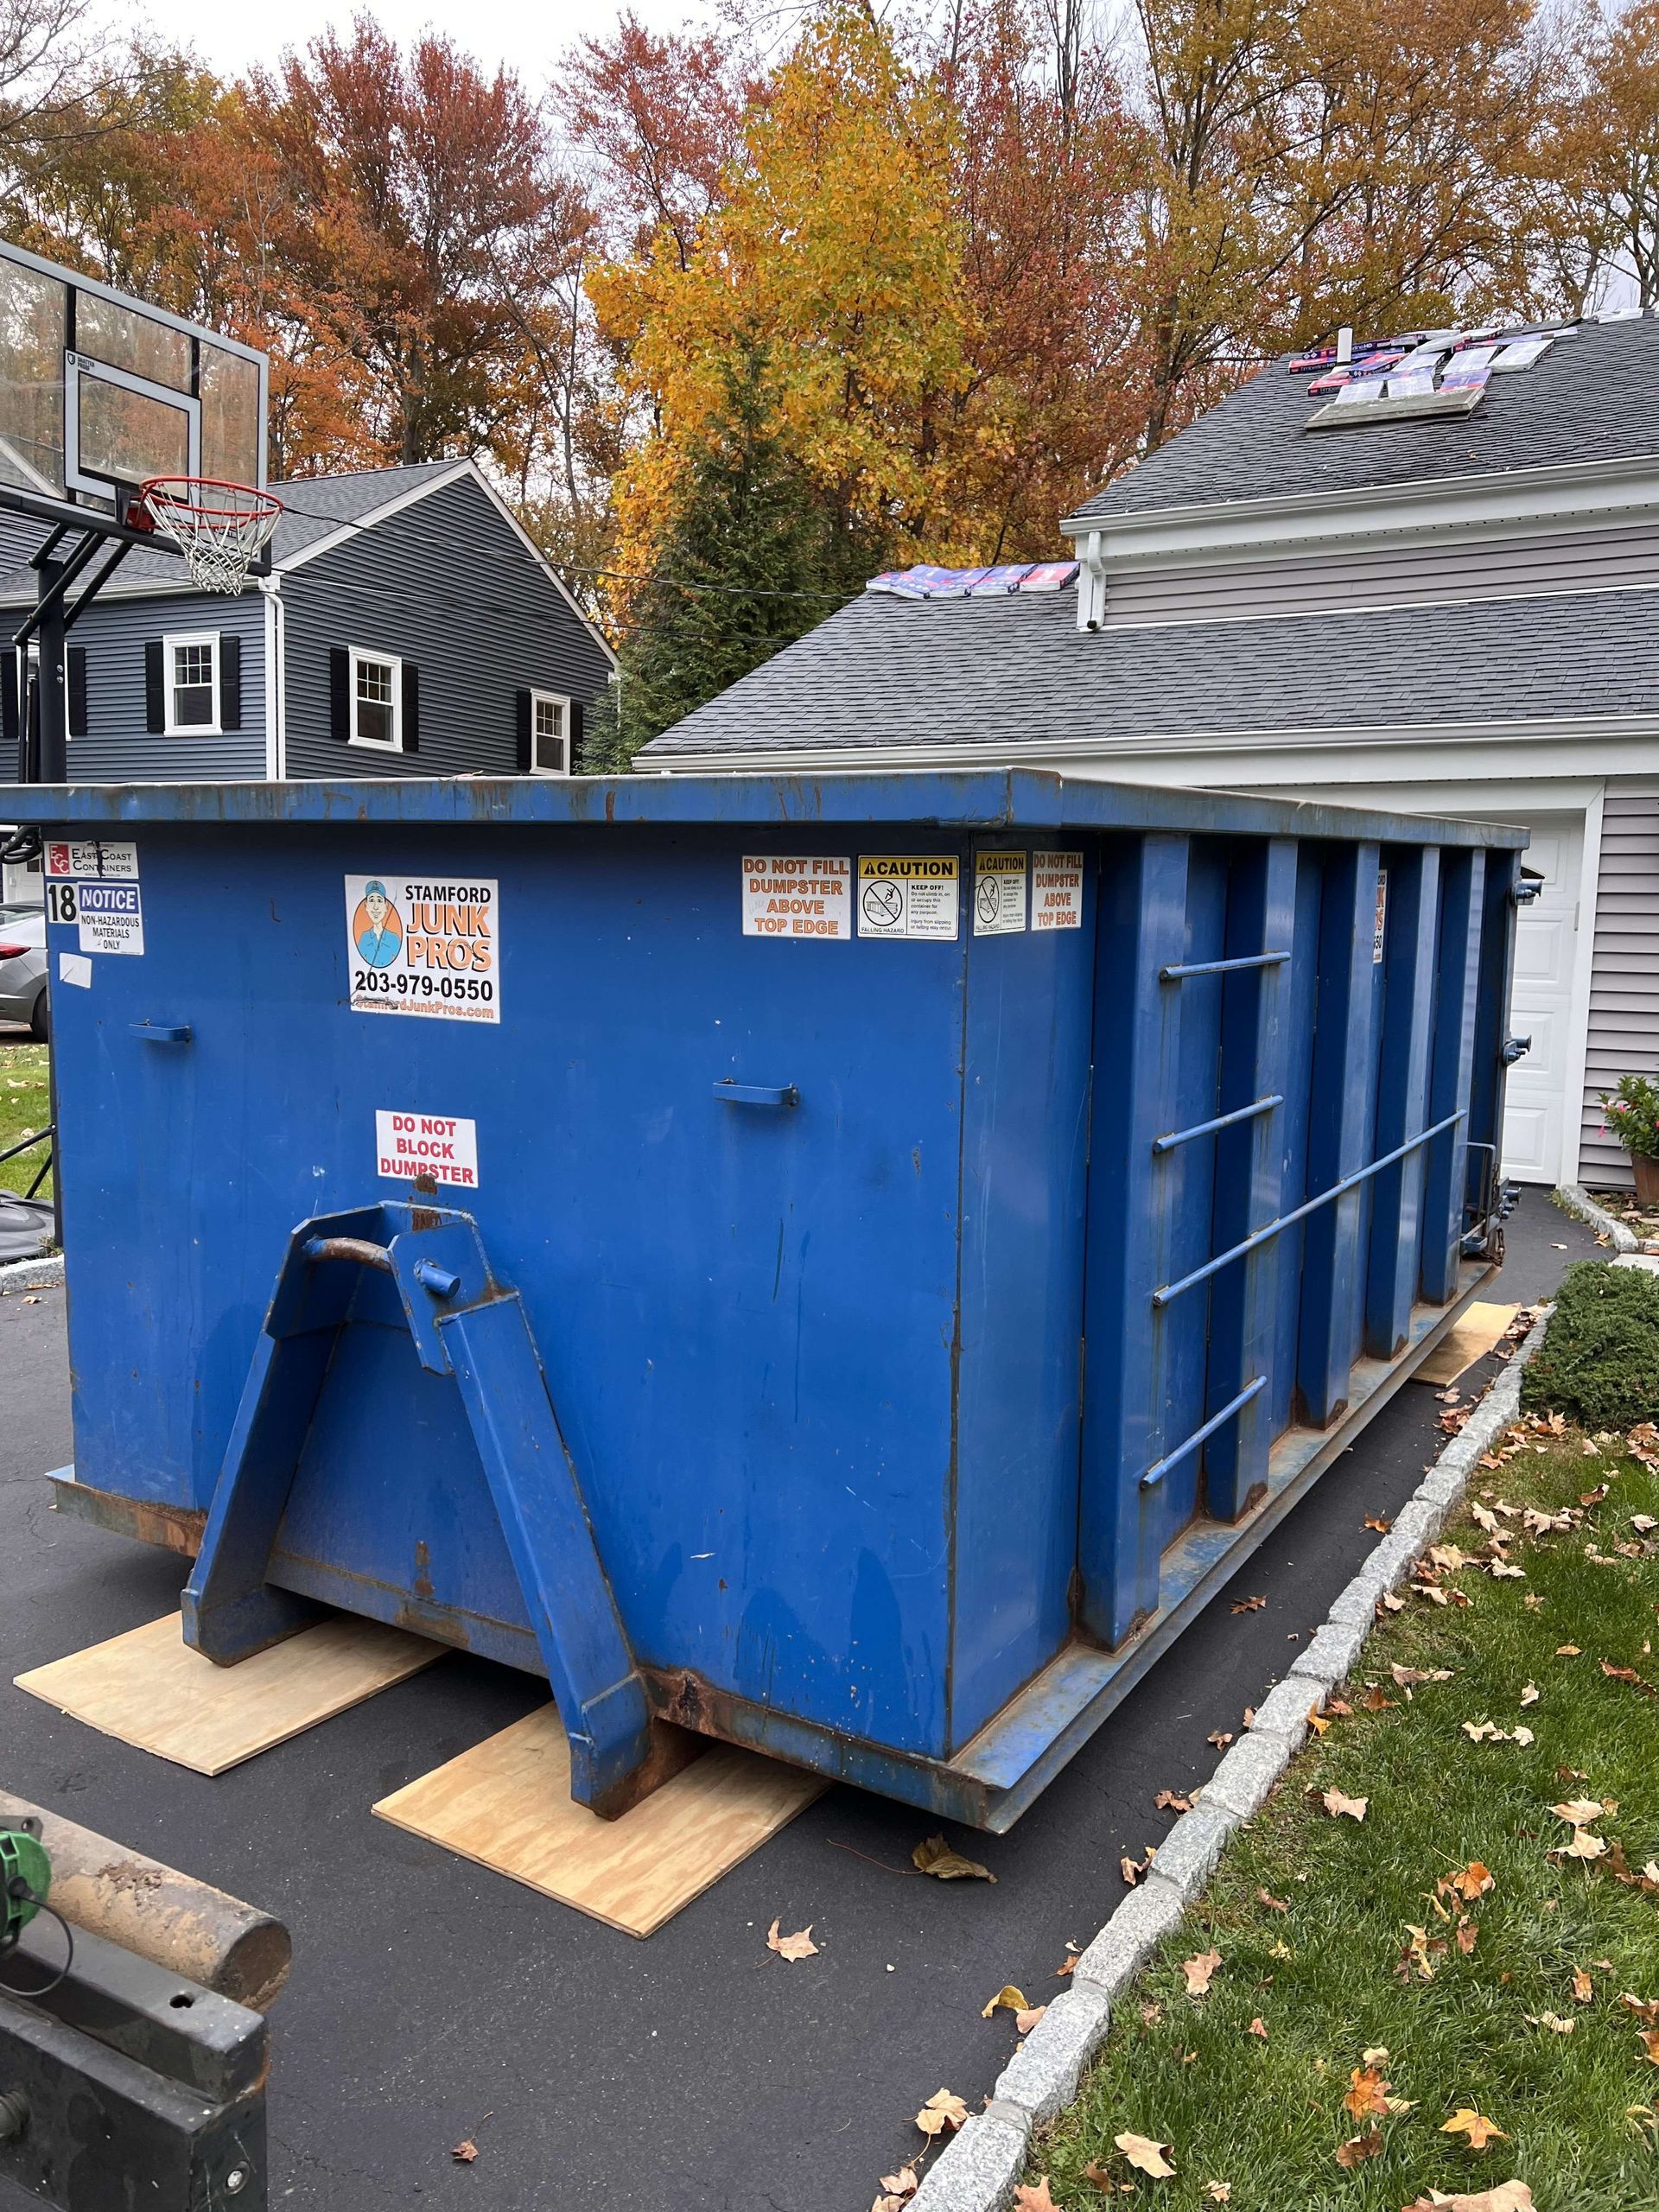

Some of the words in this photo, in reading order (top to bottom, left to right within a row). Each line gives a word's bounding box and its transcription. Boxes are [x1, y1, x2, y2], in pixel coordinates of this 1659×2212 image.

[72, 849, 98, 860] EAST
[101, 849, 132, 861] COAST
[1033, 855, 1044, 868] DO
[1048, 855, 1065, 868] NOT
[1067, 855, 1082, 869] FILL
[744, 859, 766, 873] DO
[772, 859, 807, 874] NOT
[813, 860, 849, 875] FILL
[877, 862, 953, 875] CAUTION
[986, 857, 1024, 871] CAUTION
[750, 878, 842, 895] DUMPSTER
[1036, 874, 1079, 888] DUMPSTER
[82, 889, 136, 910] NOTICE
[406, 885, 491, 903] STAMFORD
[1044, 893, 1071, 907] ABOVE
[48, 884, 76, 922] 18
[767, 899, 824, 915] ABOVE
[81, 915, 139, 927] NON-HAZARDOUS
[407, 903, 491, 938] JUNK
[755, 918, 787, 932] TOP
[793, 919, 838, 935] EDGE
[1038, 912, 1054, 927] TOP
[1056, 911, 1076, 925] EDGE
[93, 927, 130, 939] MATERIALS
[103, 940, 120, 949] ONLY
[407, 936, 492, 972] PROS
[355, 971, 493, 1001] 203-979-0550
[393, 1115, 415, 1132] DO
[421, 1119, 456, 1137] NOT
[397, 1138, 454, 1159] BLOCK
[381, 1158, 474, 1184] DUMPSTER
